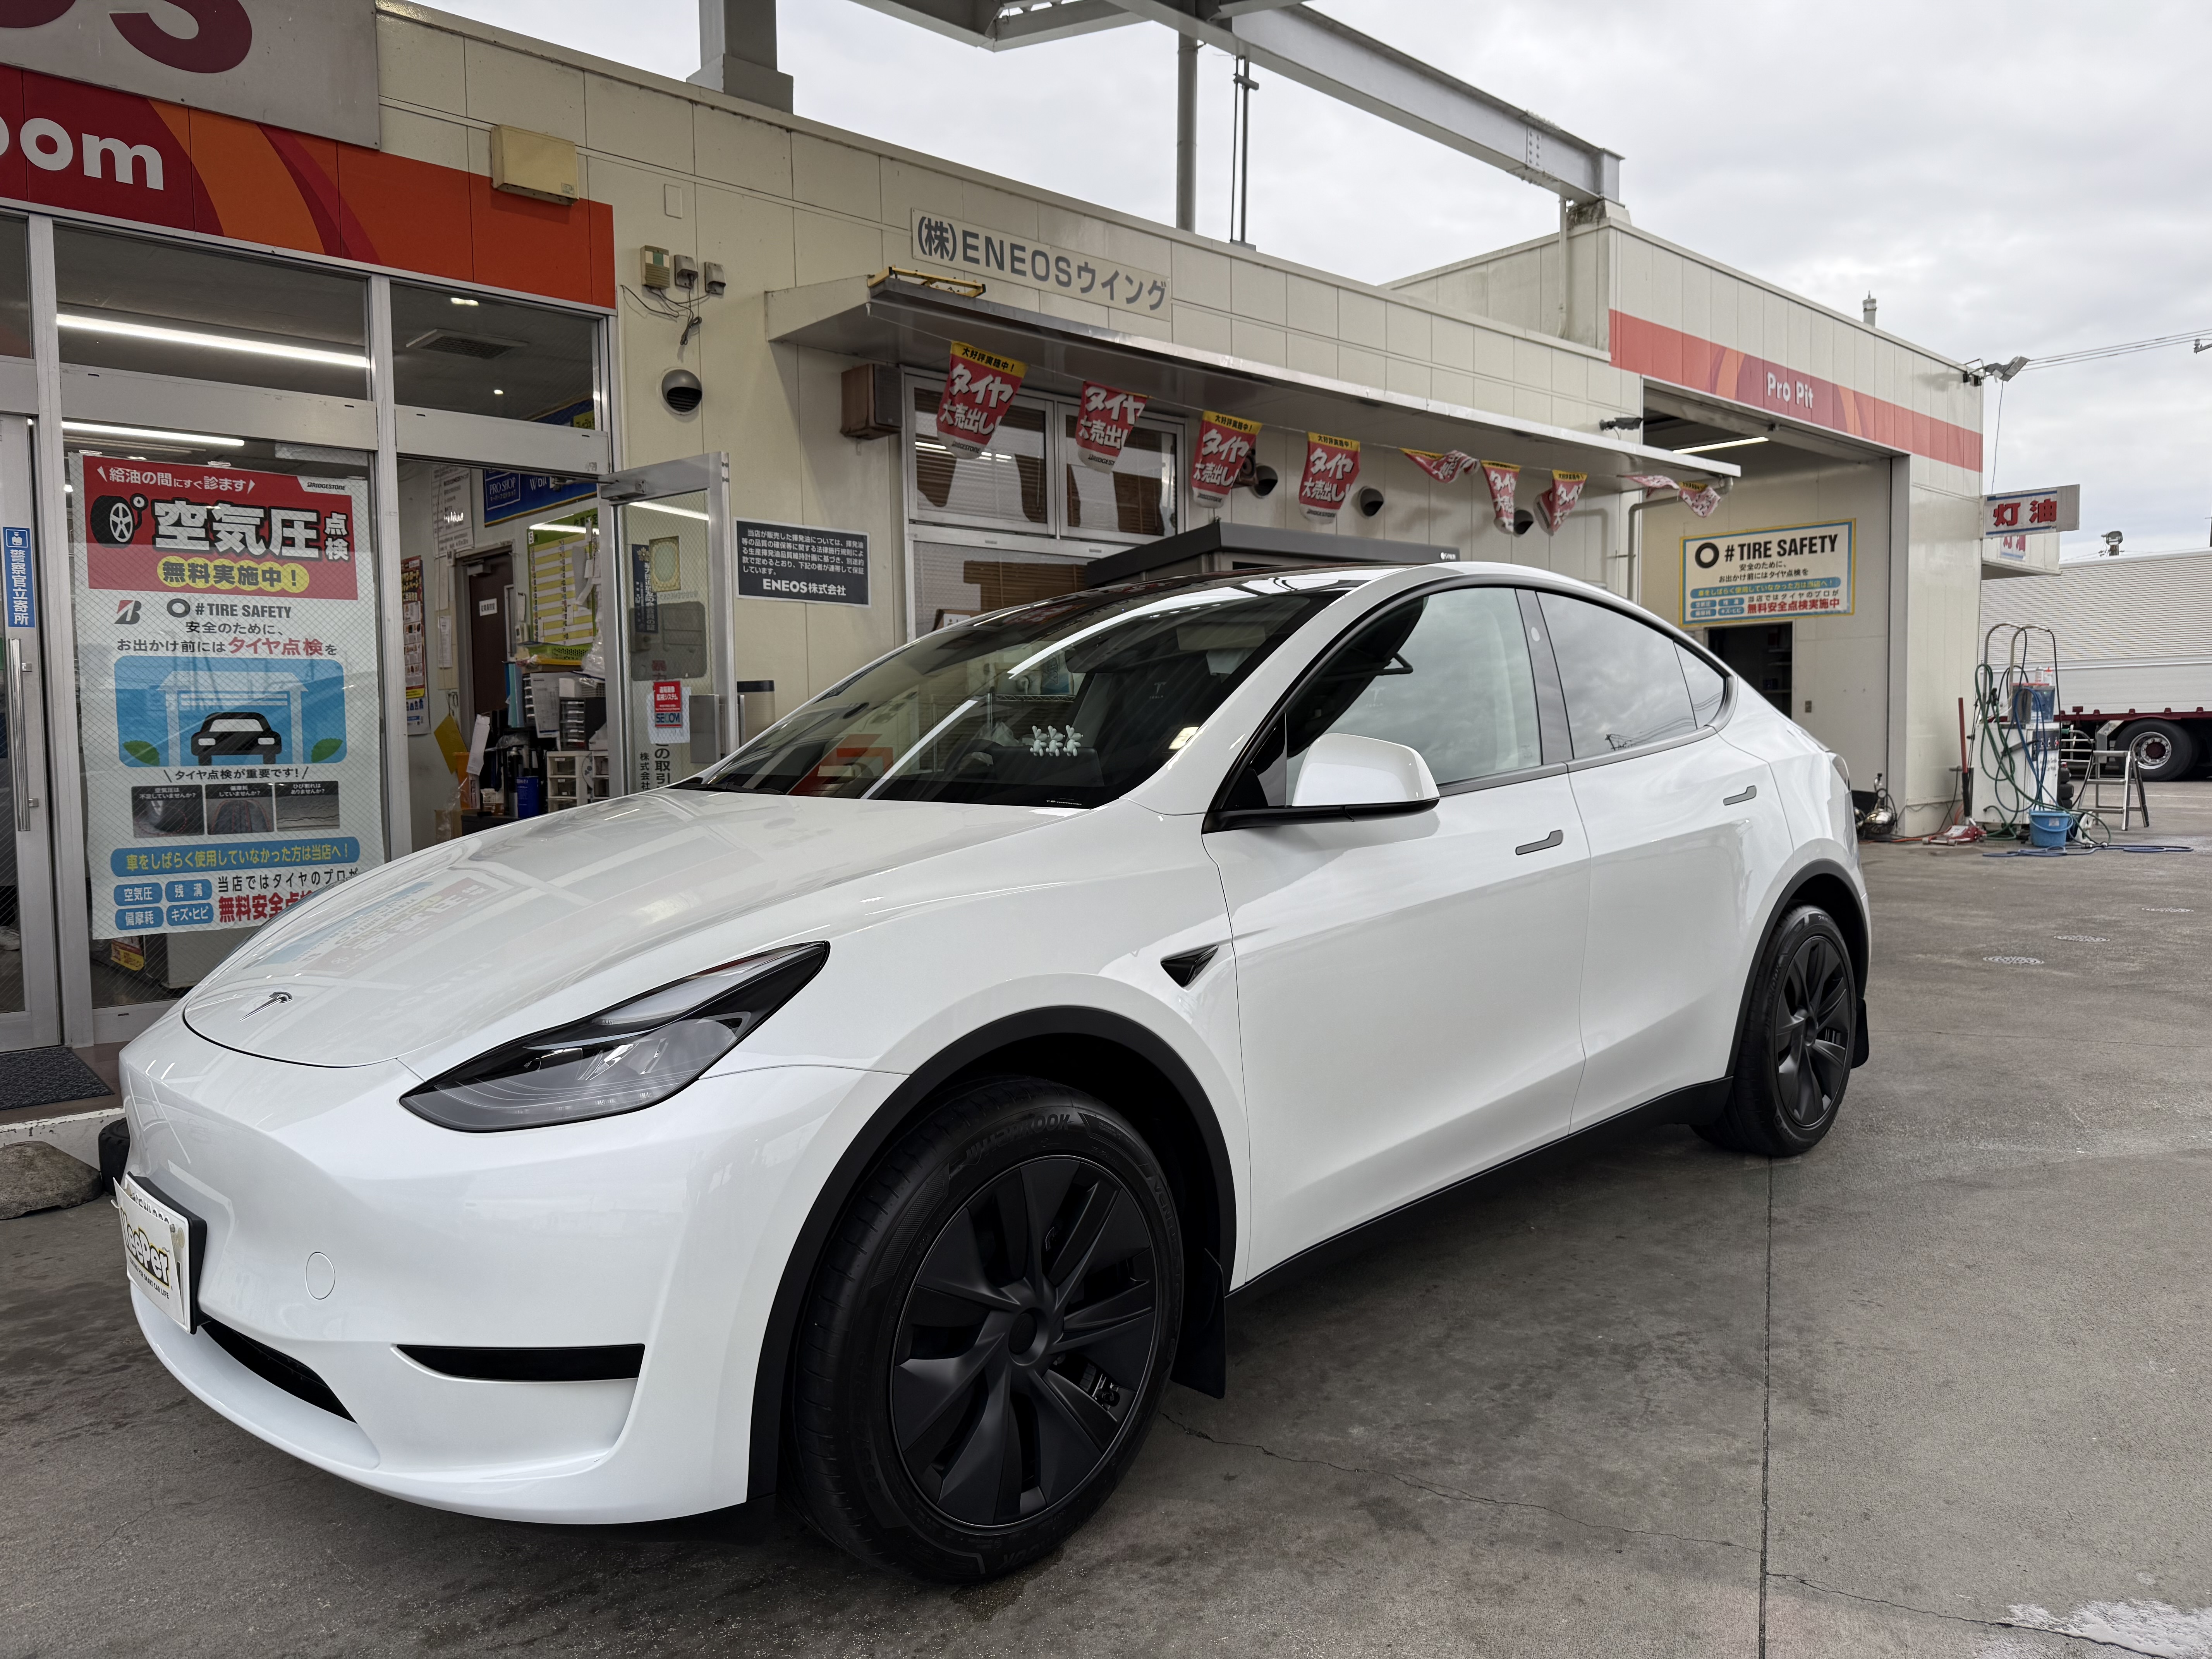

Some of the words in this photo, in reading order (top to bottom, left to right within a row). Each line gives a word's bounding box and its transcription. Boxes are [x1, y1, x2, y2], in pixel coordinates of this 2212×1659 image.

[0, 116, 164, 191] om
[918, 216, 1167, 311] (株)ENEOSウイング
[949, 363, 1014, 409] タイヤ
[1767, 371, 1791, 402] Pro
[1796, 380, 1813, 409] Pit
[1085, 386, 1146, 425] タイヤ
[1202, 428, 1250, 463] タイヤ
[1310, 448, 1355, 479] タイヤ
[109, 467, 247, 493] 給油の間にすぐ診ます
[307, 482, 346, 491] BRIDGESTONE
[489, 483, 501, 495] PRO
[502, 477, 516, 491] SHOP
[1992, 498, 2057, 527] 灯油
[153, 500, 321, 560] 空気圧
[324, 513, 349, 561] 点検
[1777, 534, 1838, 557] SAFETY
[162, 561, 297, 587] 無料実施中！
[743, 565, 776, 575] しています。
[1719, 568, 1809, 583] お出かけ前にはタイヤ点検を
[1739, 560, 1786, 572] 安全のために、
[10, 549, 29, 625] 警察官立寄所
[763, 579, 847, 596] ENEOS株式会社
[1748, 589, 1839, 603] 当店ではタイヤのプロが
[242, 604, 292, 619] SAFETY
[1747, 598, 1840, 614] 無料安全点検実施中
[185, 622, 283, 636] 安全のために、
[117, 637, 337, 656] お出かけ前にはタイヤ点検を
[656, 713, 680, 723] SECOM
[175, 768, 300, 780] タイヤ点検が重要です！
[640, 752, 650, 790] 株式会社
[654, 743, 670, 788] の取引
[126, 843, 349, 872] 車をしばらく使用していなかった方は当店へ！
[124, 886, 153, 902] 空気圧
[125, 910, 154, 926] 偏摩耗
[161, 1288, 169, 1300] LIFE
